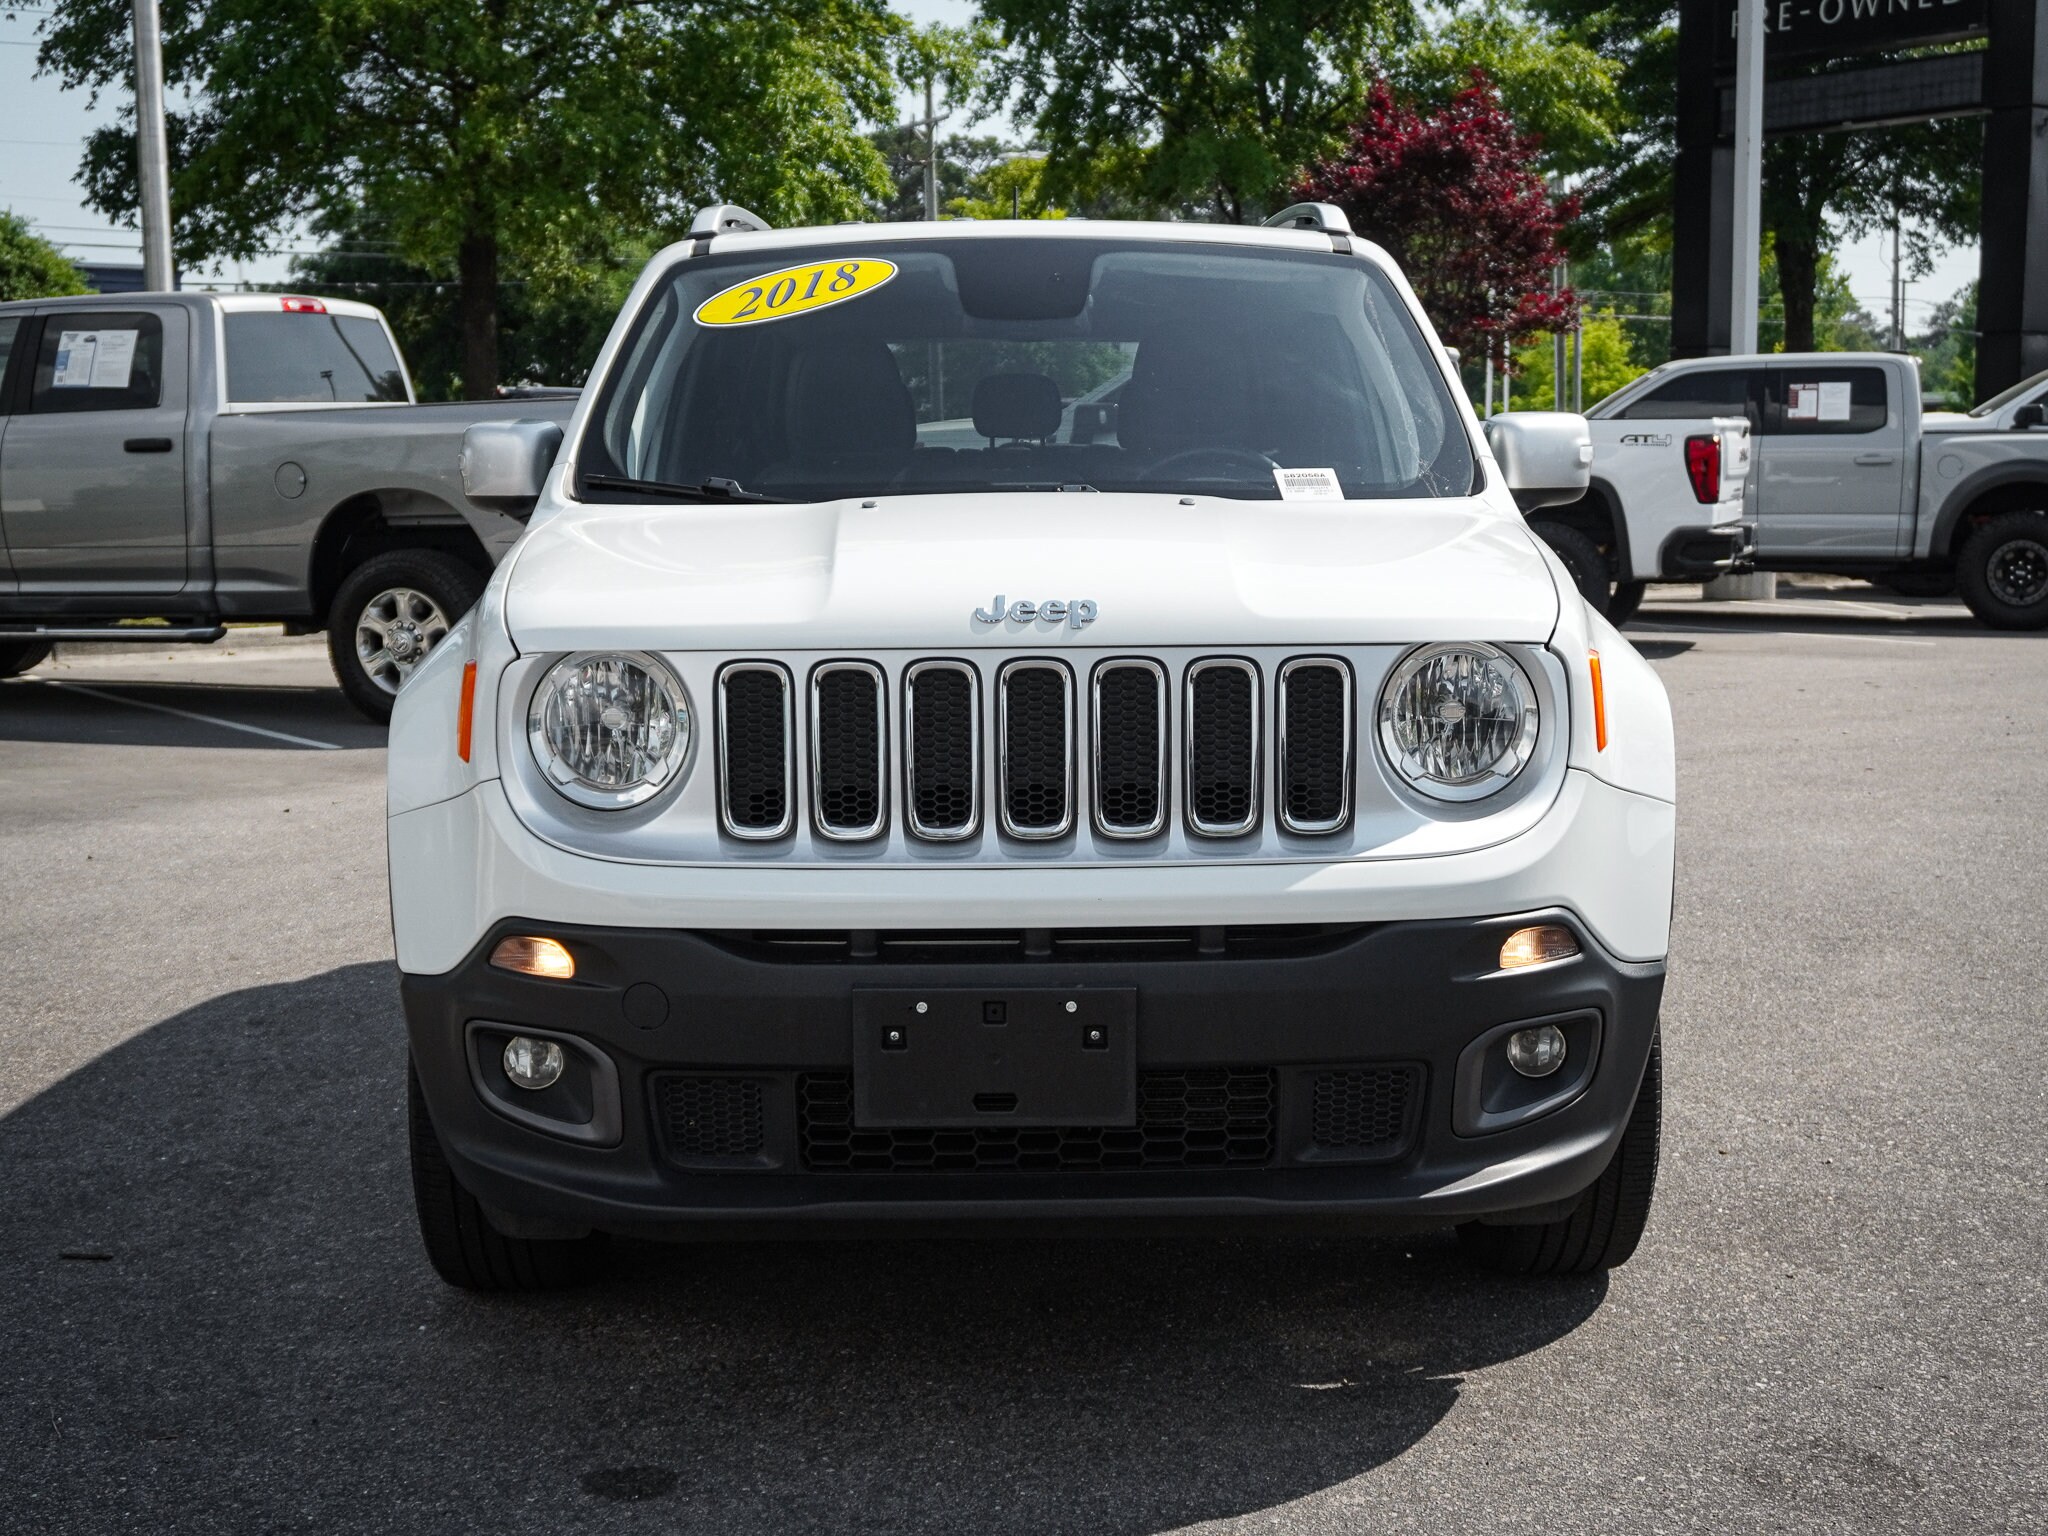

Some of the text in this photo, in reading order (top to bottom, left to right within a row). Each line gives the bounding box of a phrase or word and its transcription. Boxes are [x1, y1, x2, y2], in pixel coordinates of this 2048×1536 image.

[1728, 0, 1960, 39] PRE-OWN
[731, 263, 860, 320] 2018
[1620, 433, 1672, 447] AT4
[975, 594, 1098, 630] Jeep
